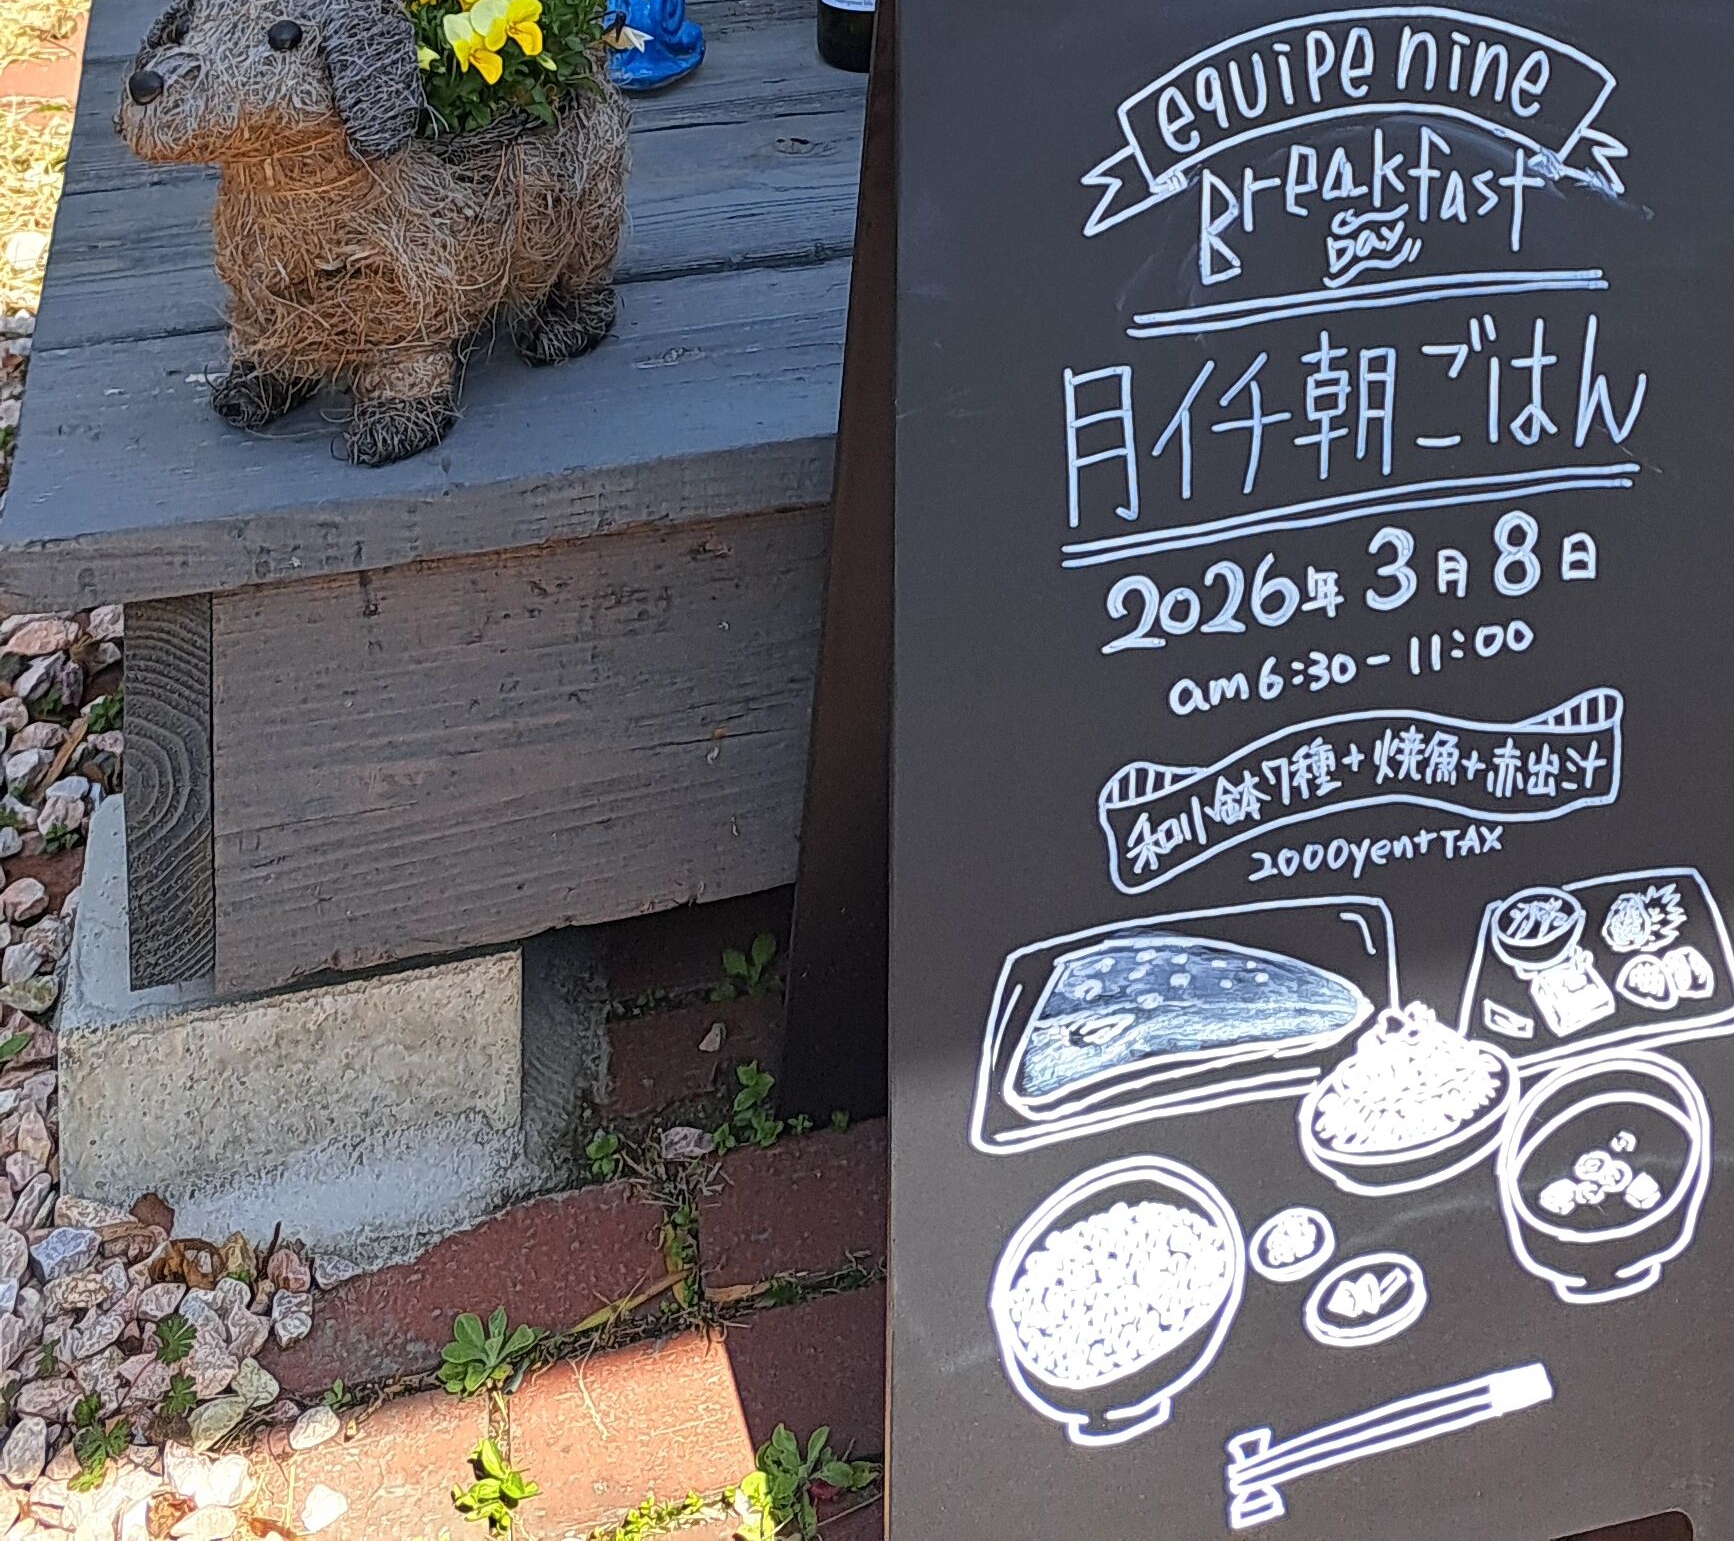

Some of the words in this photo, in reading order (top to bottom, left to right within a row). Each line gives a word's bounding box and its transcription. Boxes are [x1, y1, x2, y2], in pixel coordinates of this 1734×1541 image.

[1156, 25, 1376, 155] equipe
[1397, 24, 1553, 117] nine
[1199, 124, 1547, 287] Breakfast
[1062, 314, 1648, 530] 月イチ朝ごはん
